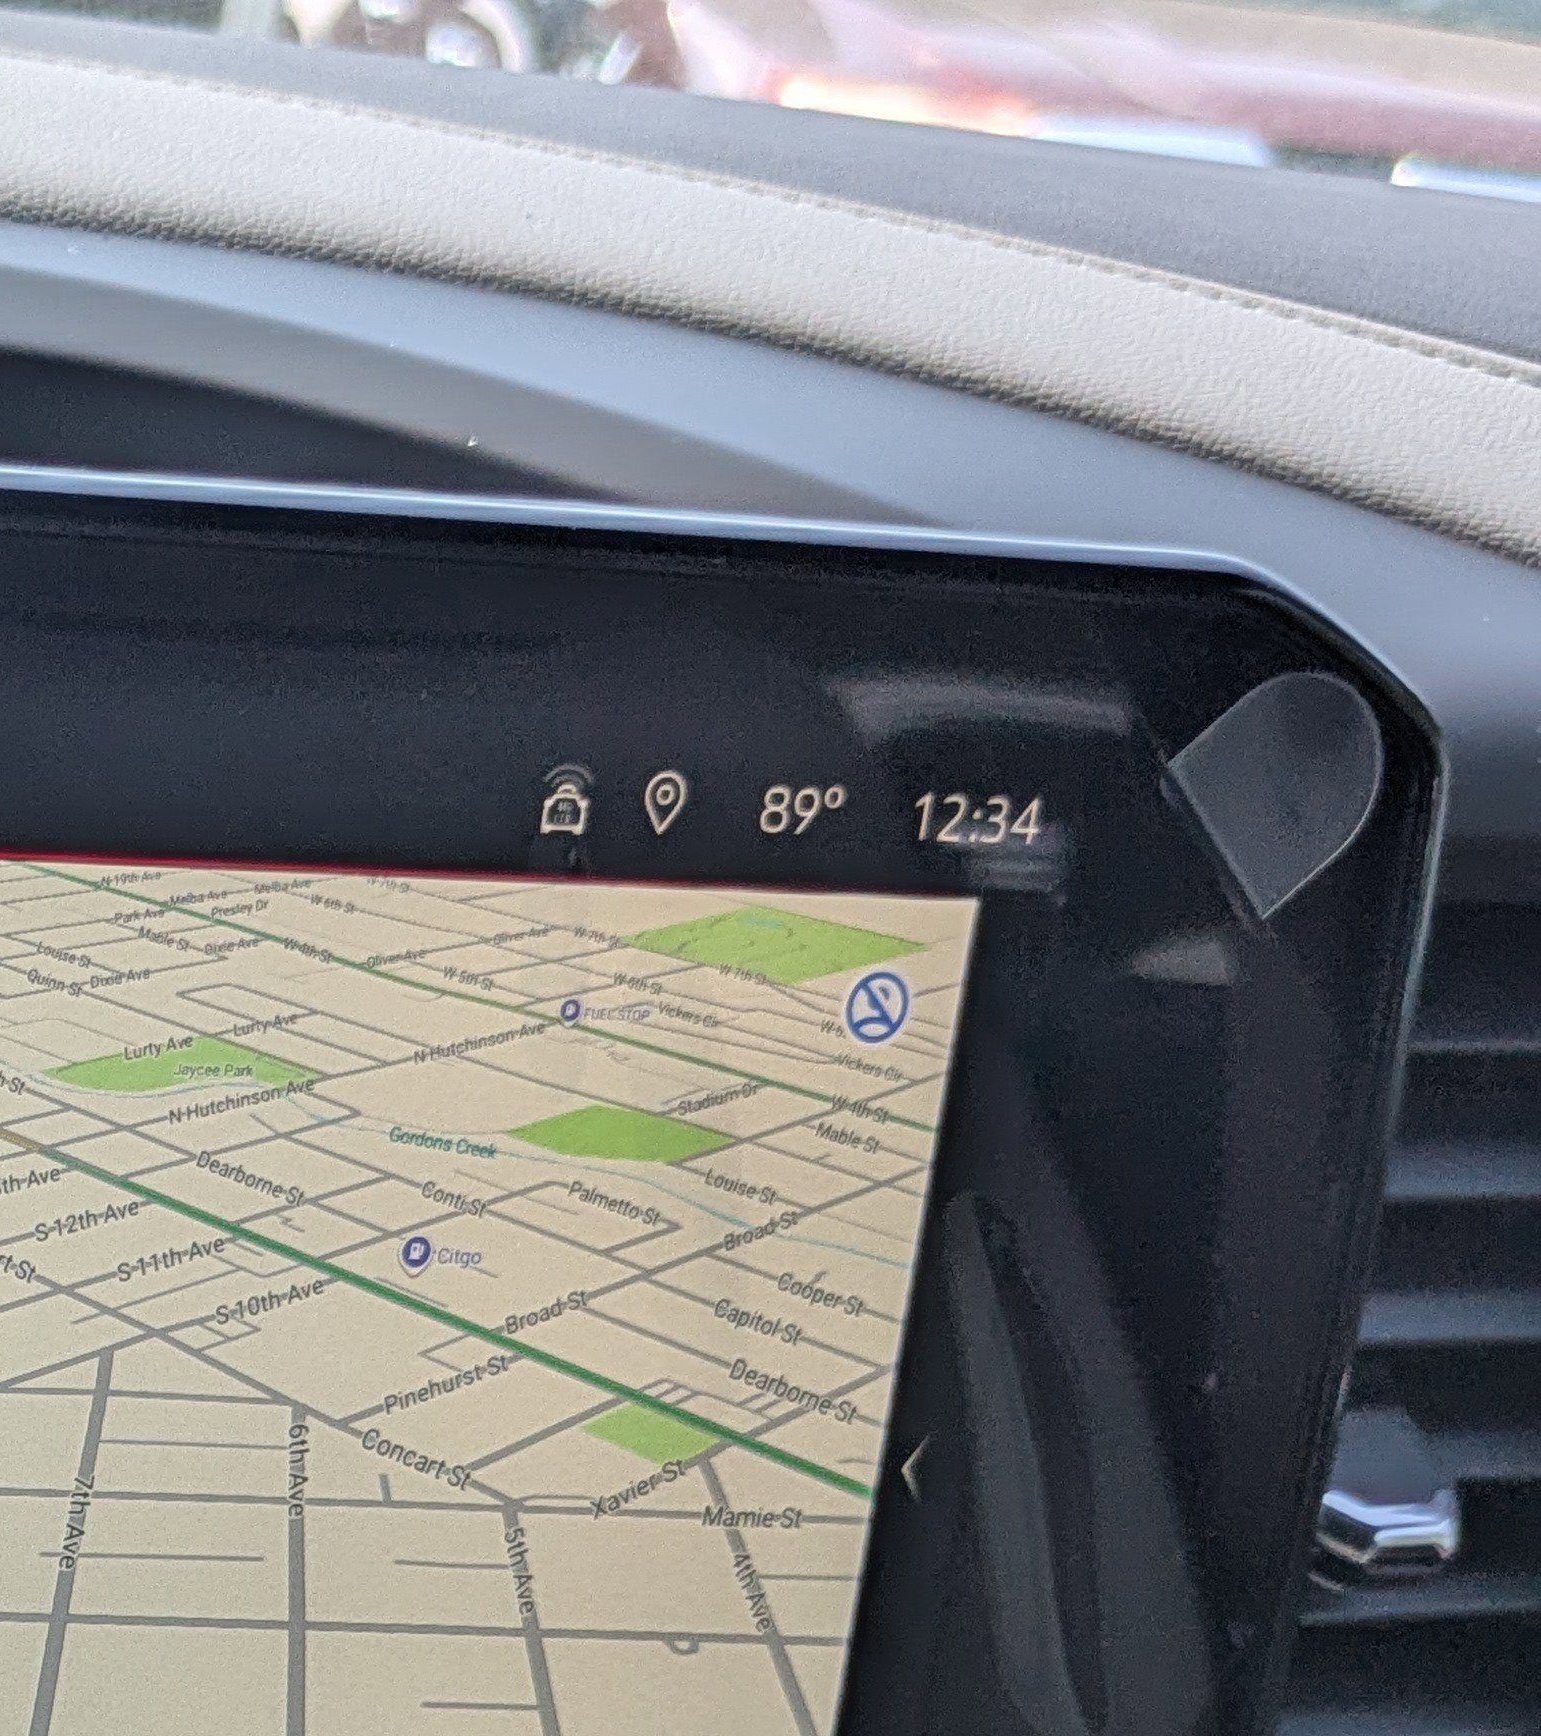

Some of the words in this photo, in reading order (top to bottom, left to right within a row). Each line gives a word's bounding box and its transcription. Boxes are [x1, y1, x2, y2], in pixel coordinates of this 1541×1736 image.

[915, 792, 1042, 845] 12:34
[4, 1074, 26, 1095] St
[174, 1063, 219, 1080] Jaycee
[223, 1064, 253, 1078] Park
[568, 1181, 639, 1219] Palmetto
[637, 1205, 662, 1226] St
[13, 1259, 37, 1283] St
[438, 1246, 483, 1268] Citgo
[504, 1299, 561, 1334] Broad
[560, 1289, 588, 1311] St
[776, 1273, 836, 1312] Cooper
[833, 1294, 865, 1317] St
[714, 1300, 781, 1340] Capitol
[777, 1322, 803, 1346] St
[384, 1363, 481, 1415] Pinehurst
[484, 1353, 509, 1376] St
[728, 1358, 832, 1416] Dearborne
[830, 1401, 860, 1424] St
[287, 1423, 308, 1467] 6th
[360, 1430, 445, 1477] Concart
[446, 1465, 473, 1491] St
[67, 1475, 96, 1517] 7th
[288, 1472, 307, 1517] Ave
[588, 1468, 662, 1519] Xavier
[658, 1458, 686, 1485] St
[702, 1506, 770, 1529] Mamie
[777, 1508, 803, 1529] St
[58, 1523, 85, 1571] Ave
[504, 1527, 531, 1571] 5th
[512, 1573, 535, 1614] Ave
[732, 1553, 759, 1596] 4th
[746, 1590, 771, 1633] Ave
